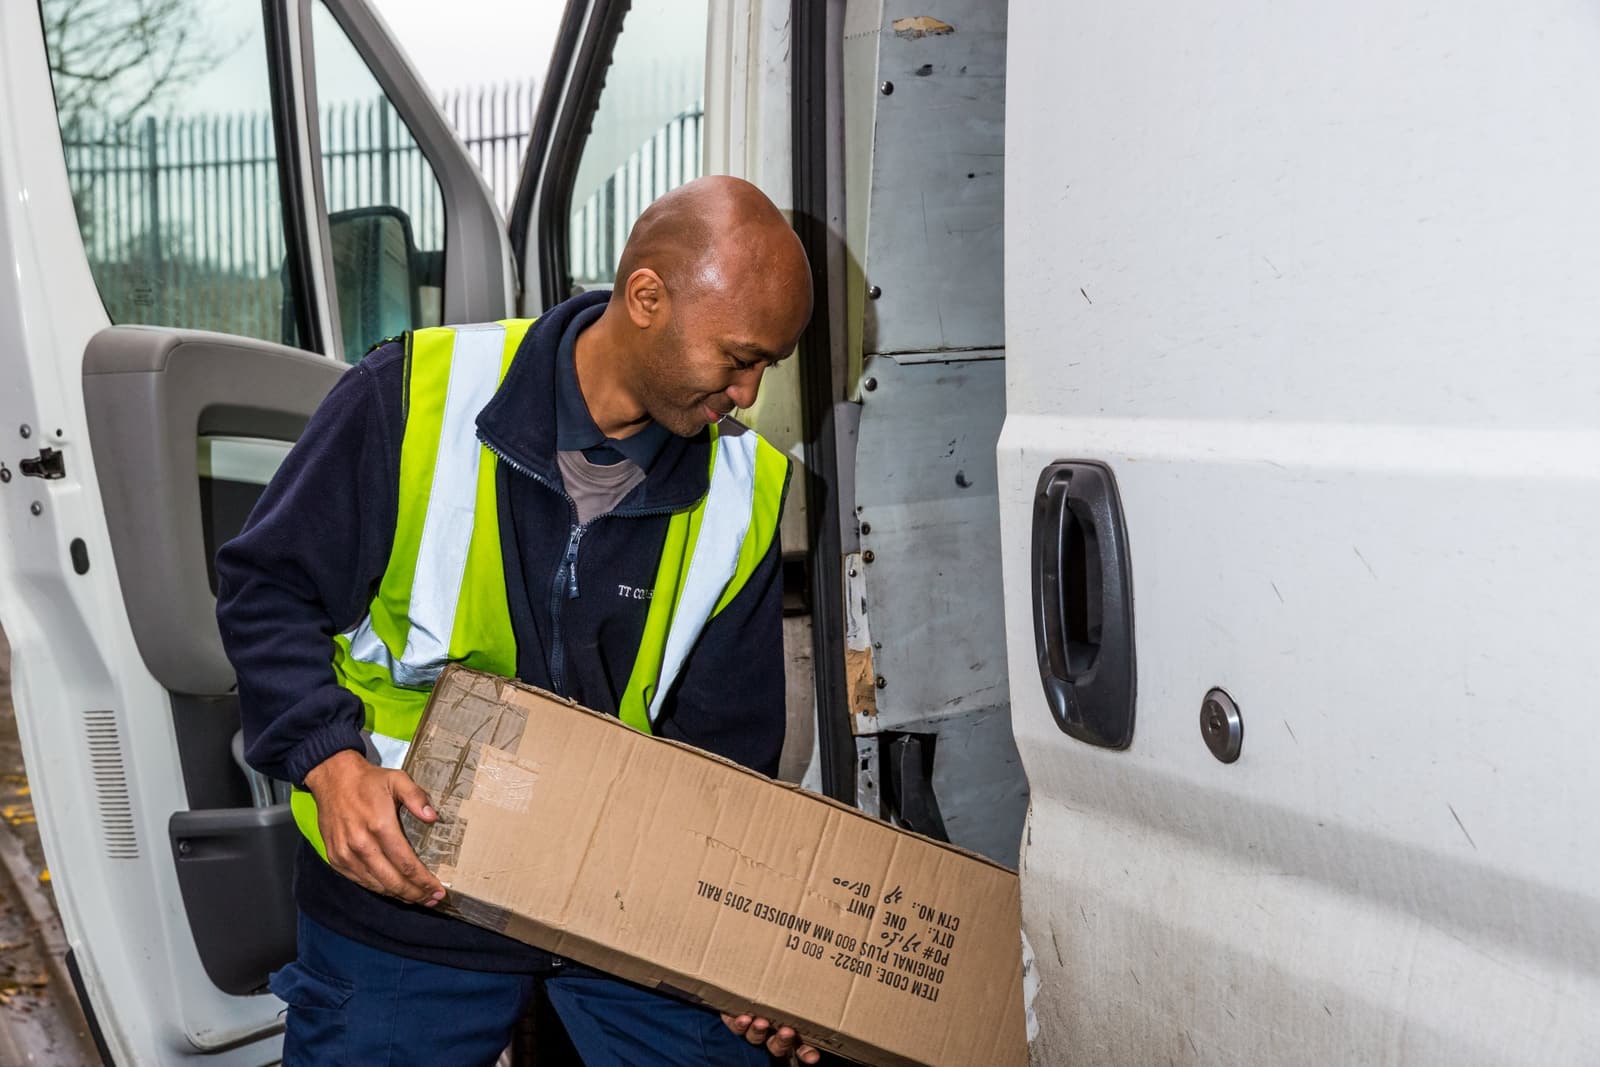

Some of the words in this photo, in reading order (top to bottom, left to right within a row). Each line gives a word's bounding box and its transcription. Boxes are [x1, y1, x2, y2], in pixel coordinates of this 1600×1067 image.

[618, 584, 632, 598] TT
[697, 880, 723, 902] RAIL
[723, 891, 753, 913] 2015
[846, 898, 876, 919] UNIT
[912, 902, 935, 921] NO.:
[753, 902, 811, 934] ANODISED
[882, 910, 907, 931] ONE
[937, 911, 960, 931] CTN
[785, 934, 800, 950] C1
[812, 923, 834, 943] MM
[835, 933, 857, 952] 800
[801, 940, 825, 960] 800
[859, 941, 890, 963] PLUS
[922, 946, 950, 966] PO#
[830, 952, 873, 978] UB322-
[892, 952, 945, 984] ORIGINAL
[876, 966, 910, 991] CODE:
[911, 980, 940, 1002] ITEM
